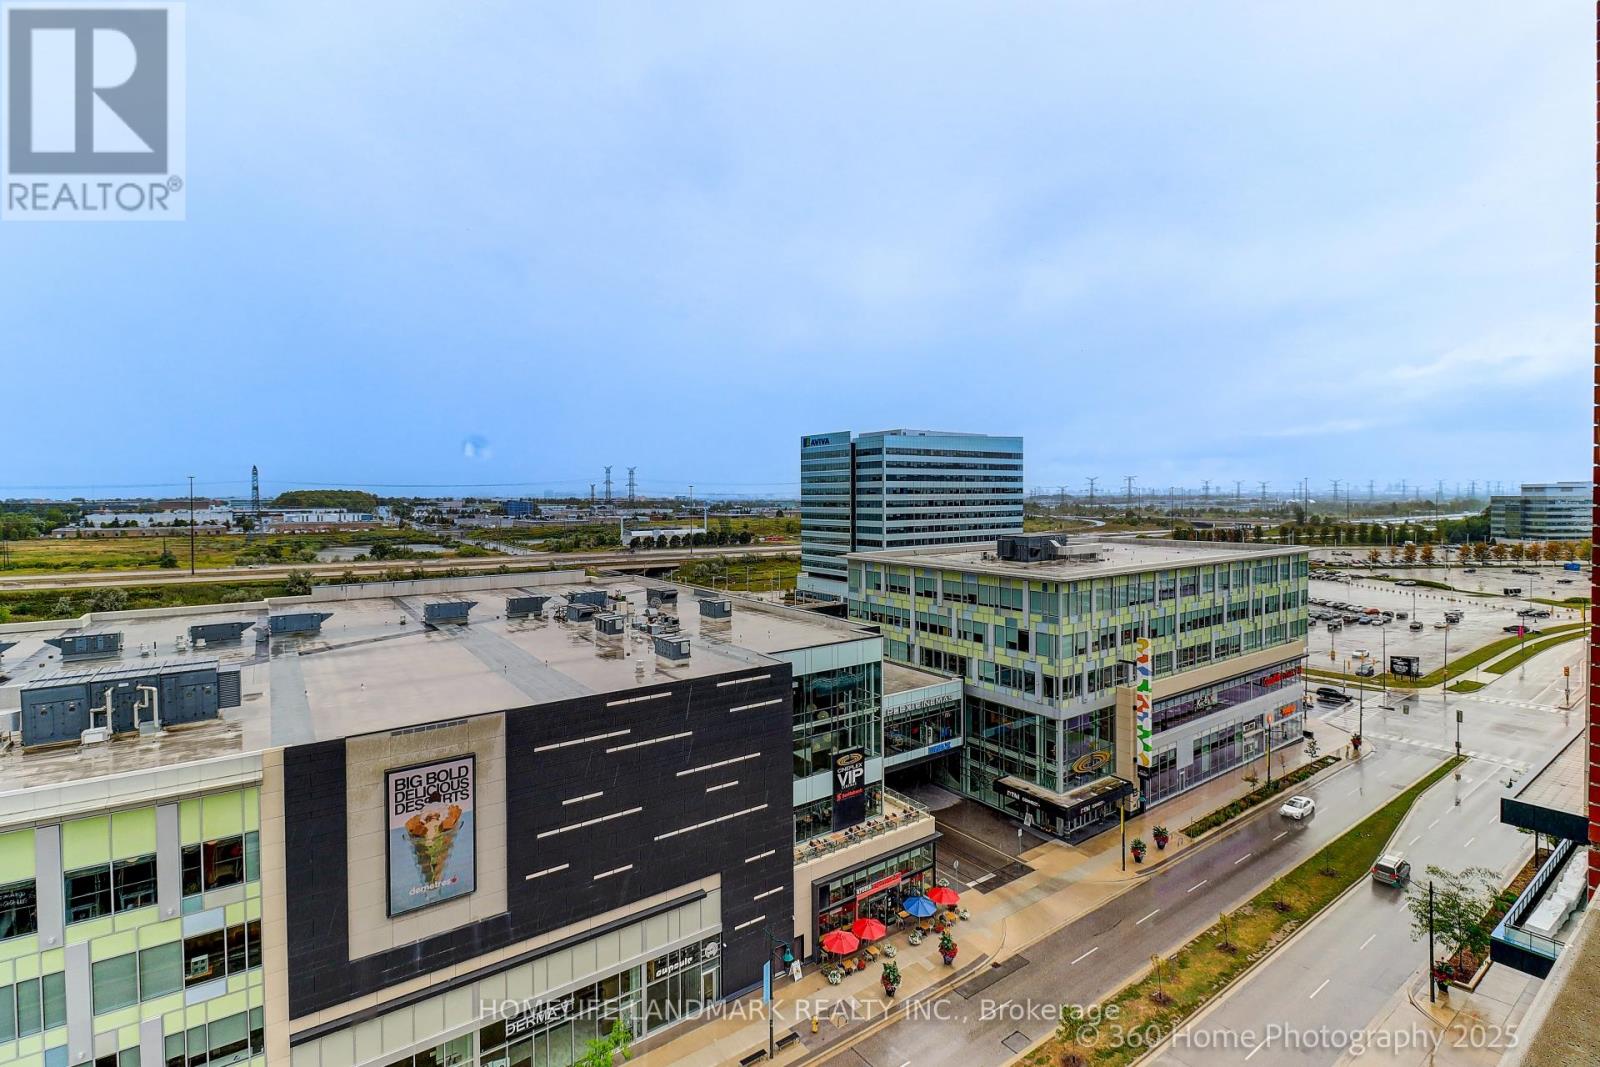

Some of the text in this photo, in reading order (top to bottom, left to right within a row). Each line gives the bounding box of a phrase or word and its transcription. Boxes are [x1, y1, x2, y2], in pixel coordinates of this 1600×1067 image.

[394, 765, 469, 792] BIG BOLD
[394, 777, 470, 804] DELICIOUS
[837, 768, 864, 787] VIP
[394, 789, 470, 817] DESRTS
